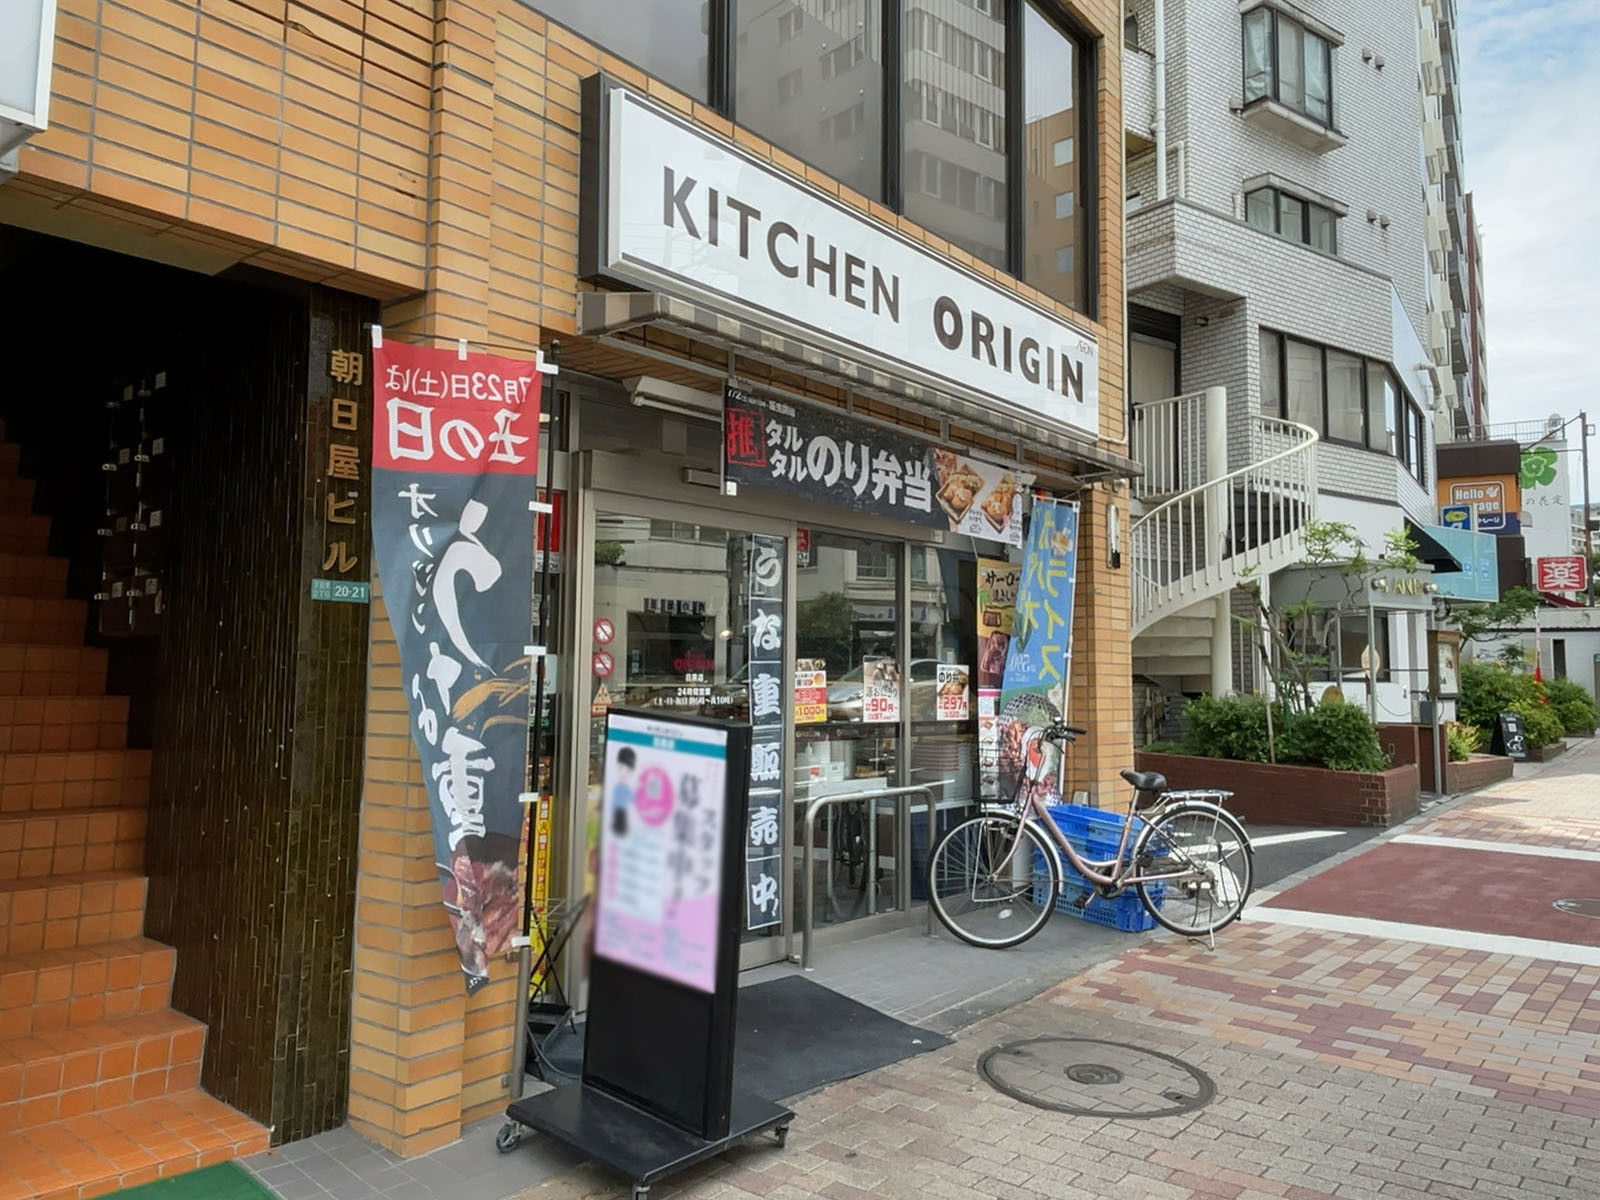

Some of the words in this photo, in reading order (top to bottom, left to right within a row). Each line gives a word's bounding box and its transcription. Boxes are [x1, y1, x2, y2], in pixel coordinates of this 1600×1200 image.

[663, 165, 900, 324] KITCHEN
[932, 294, 1084, 404] ORIGIN
[322, 349, 364, 573] 朝日屋ビル
[806, 434, 932, 513] のり弁当
[1455, 488, 1484, 500] Hello
[334, 584, 365, 599] 20-21
[1542, 561, 1581, 588] 薬
